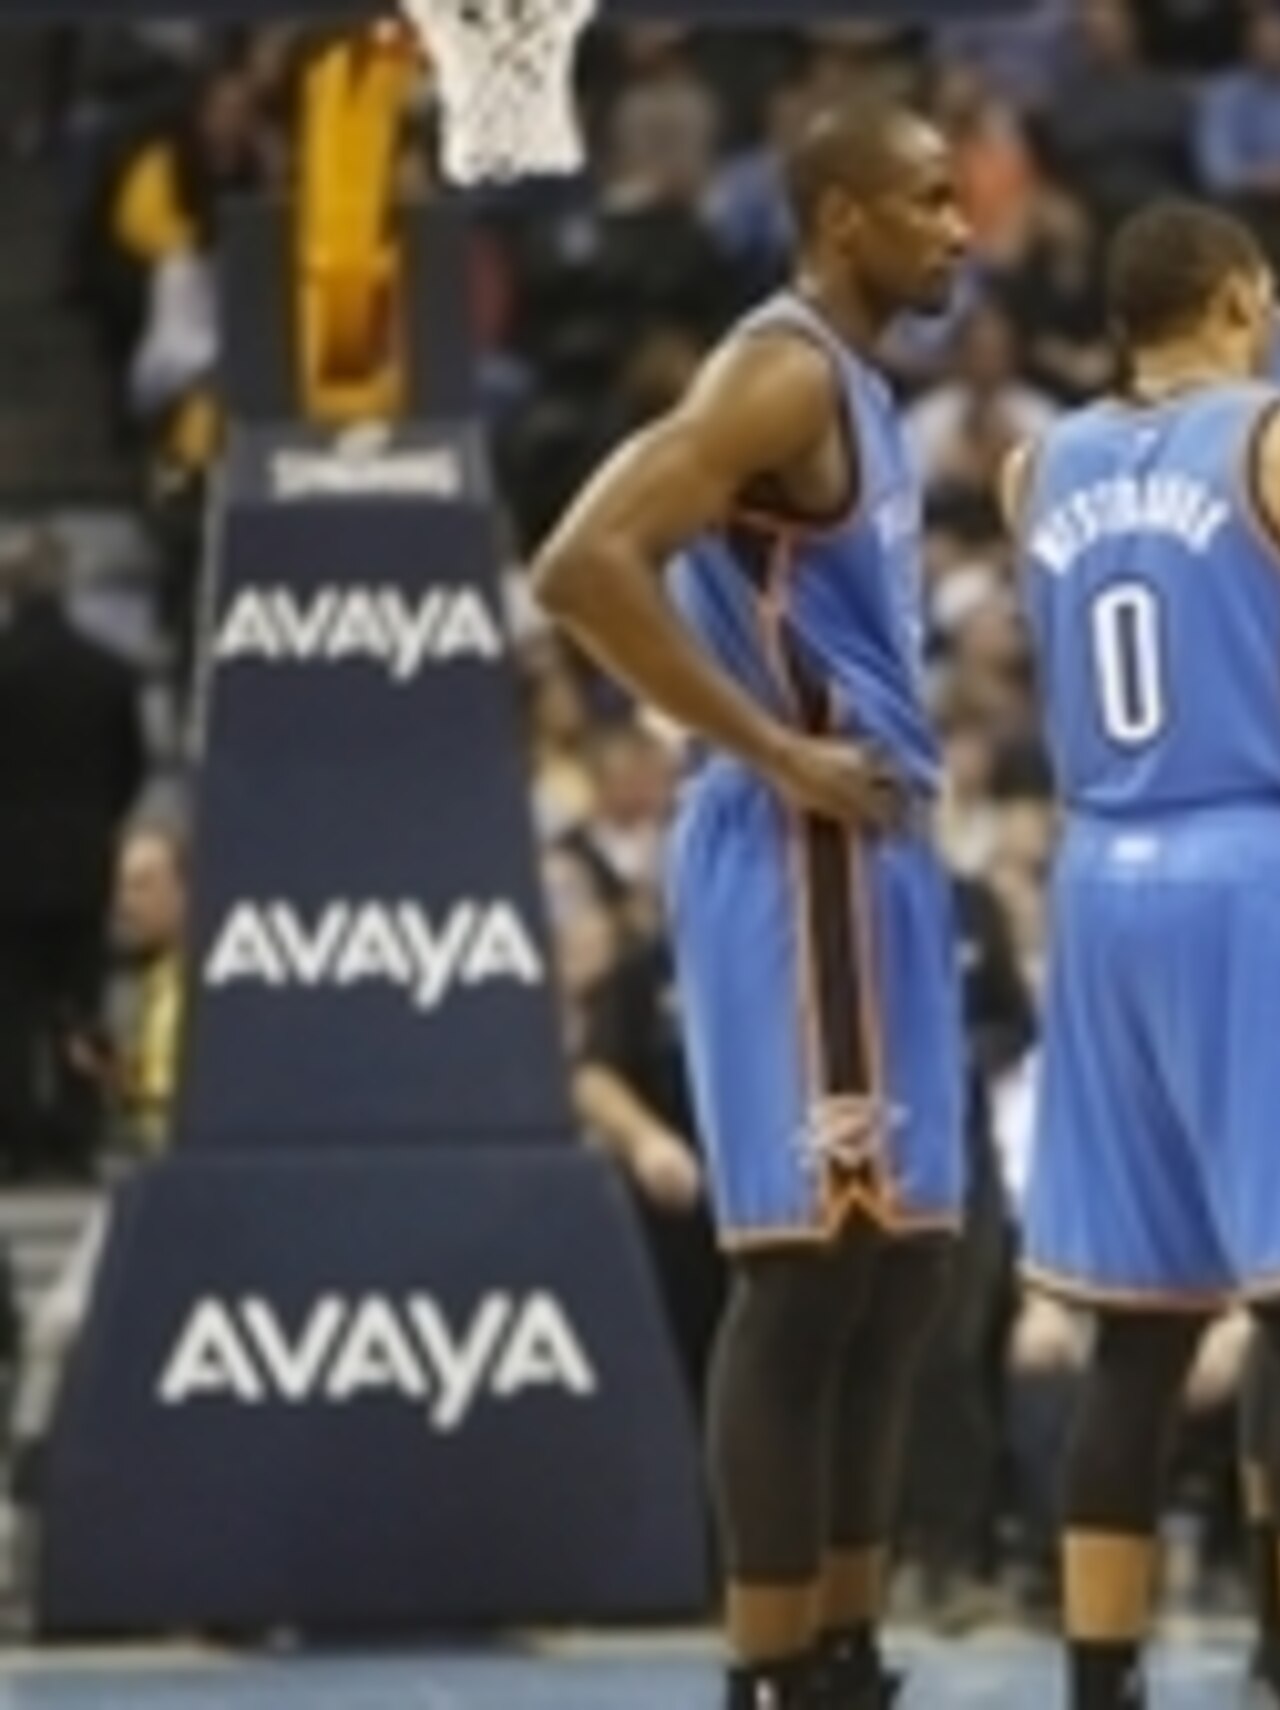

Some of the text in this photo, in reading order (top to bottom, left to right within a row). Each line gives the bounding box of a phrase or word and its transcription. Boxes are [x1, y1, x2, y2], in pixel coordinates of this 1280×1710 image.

[215, 587, 502, 680] AVAYA
[1092, 584, 1162, 742] 0
[205, 898, 544, 1010] AVAYA
[160, 1292, 595, 1428] AVAYA
